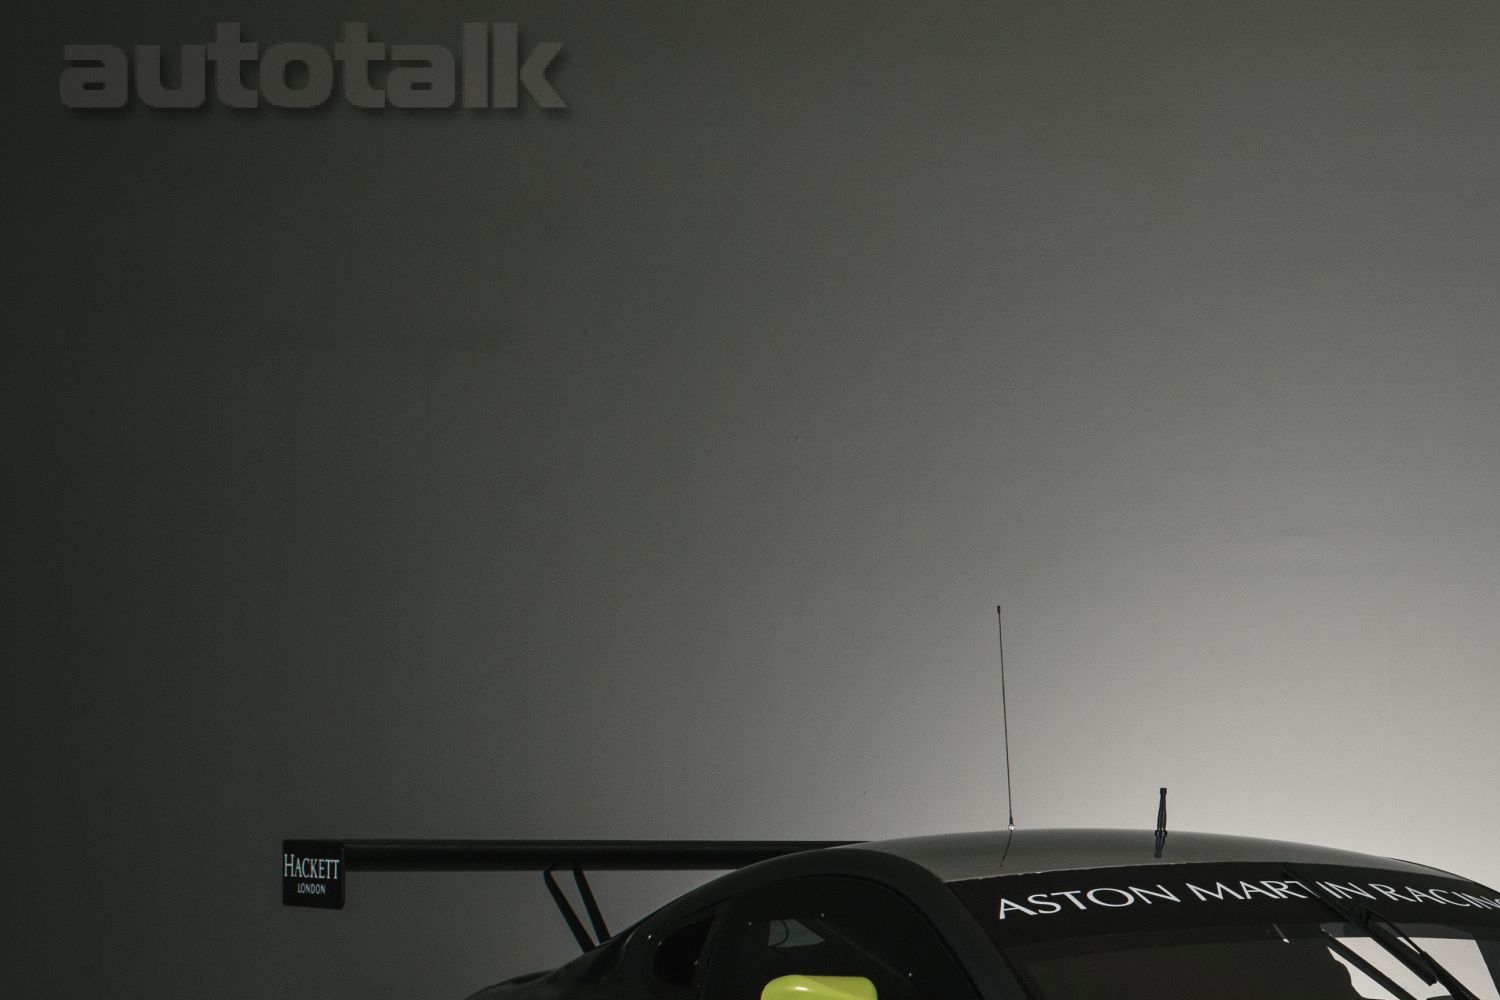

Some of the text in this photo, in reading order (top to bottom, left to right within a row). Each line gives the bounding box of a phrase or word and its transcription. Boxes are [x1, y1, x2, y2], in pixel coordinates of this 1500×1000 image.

[284, 853, 340, 879] HACKETT
[297, 882, 326, 895] LONDON
[999, 885, 1181, 920] ASTON
[1186, 879, 1377, 901] MARTIN
